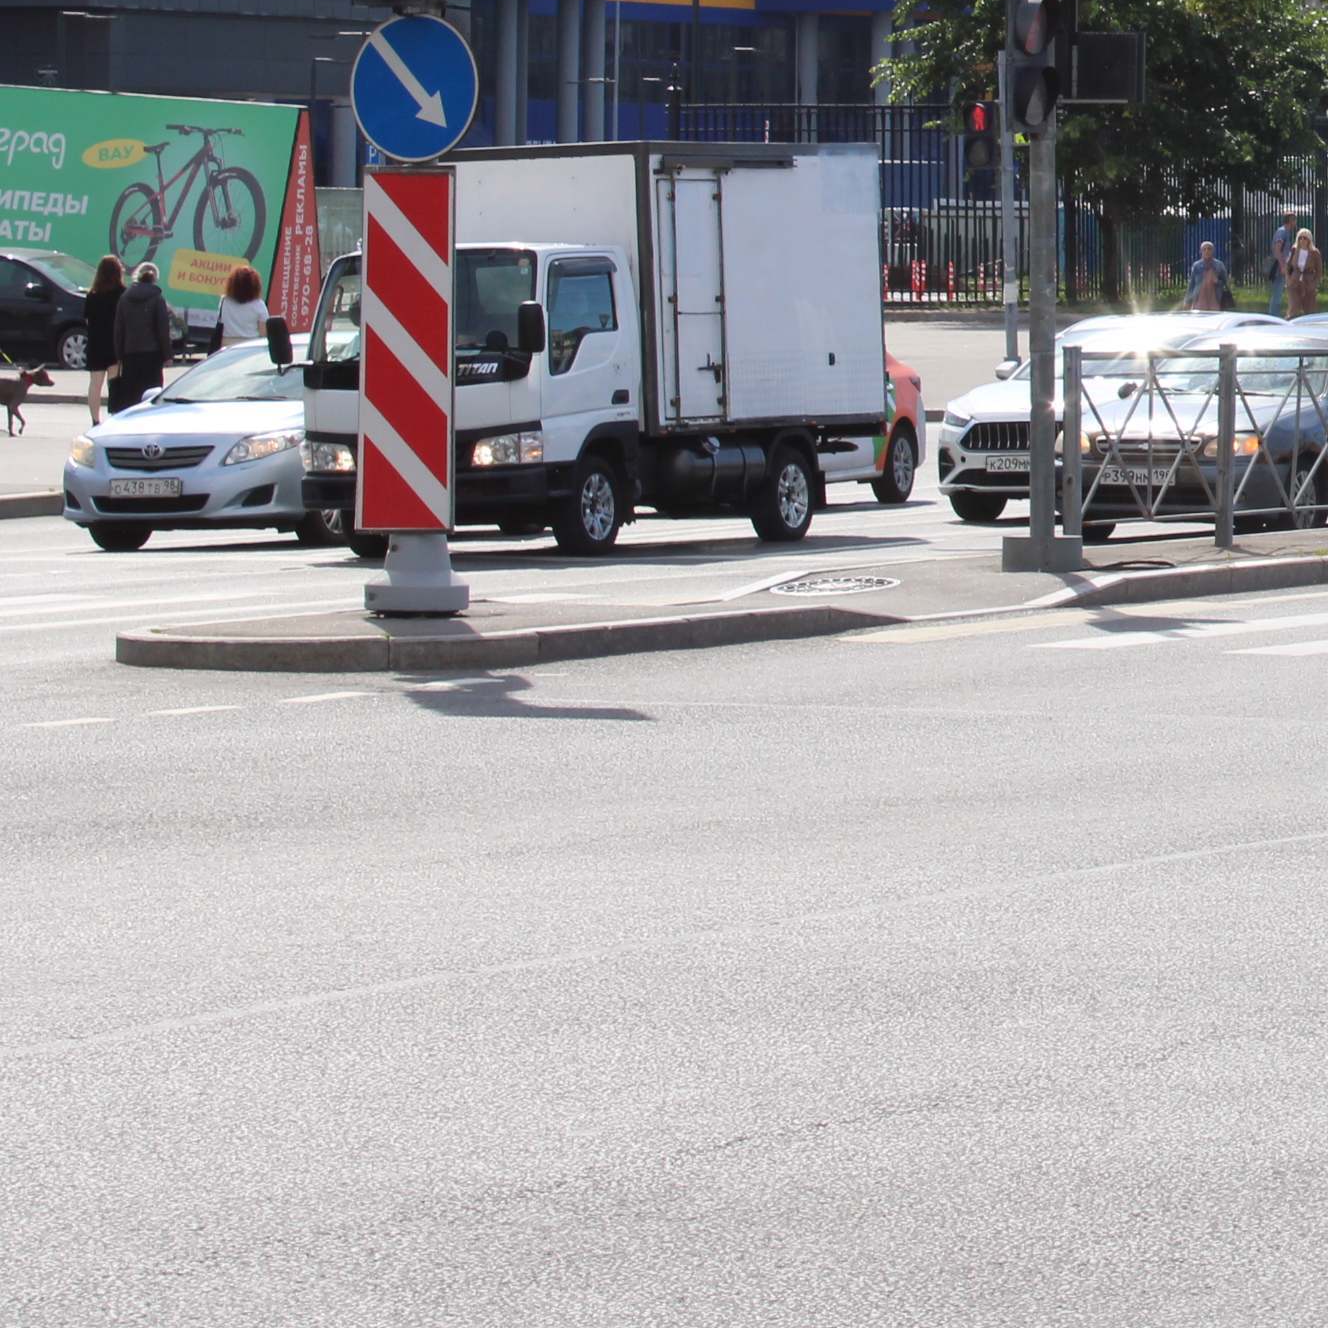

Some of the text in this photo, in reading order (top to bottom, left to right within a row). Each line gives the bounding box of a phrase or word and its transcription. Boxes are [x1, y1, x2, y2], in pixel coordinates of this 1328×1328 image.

[99, 146, 135, 162] ВАУ
[295, 145, 307, 235] РЕКЛАМЫ
[457, 363, 498, 376] TITAN
